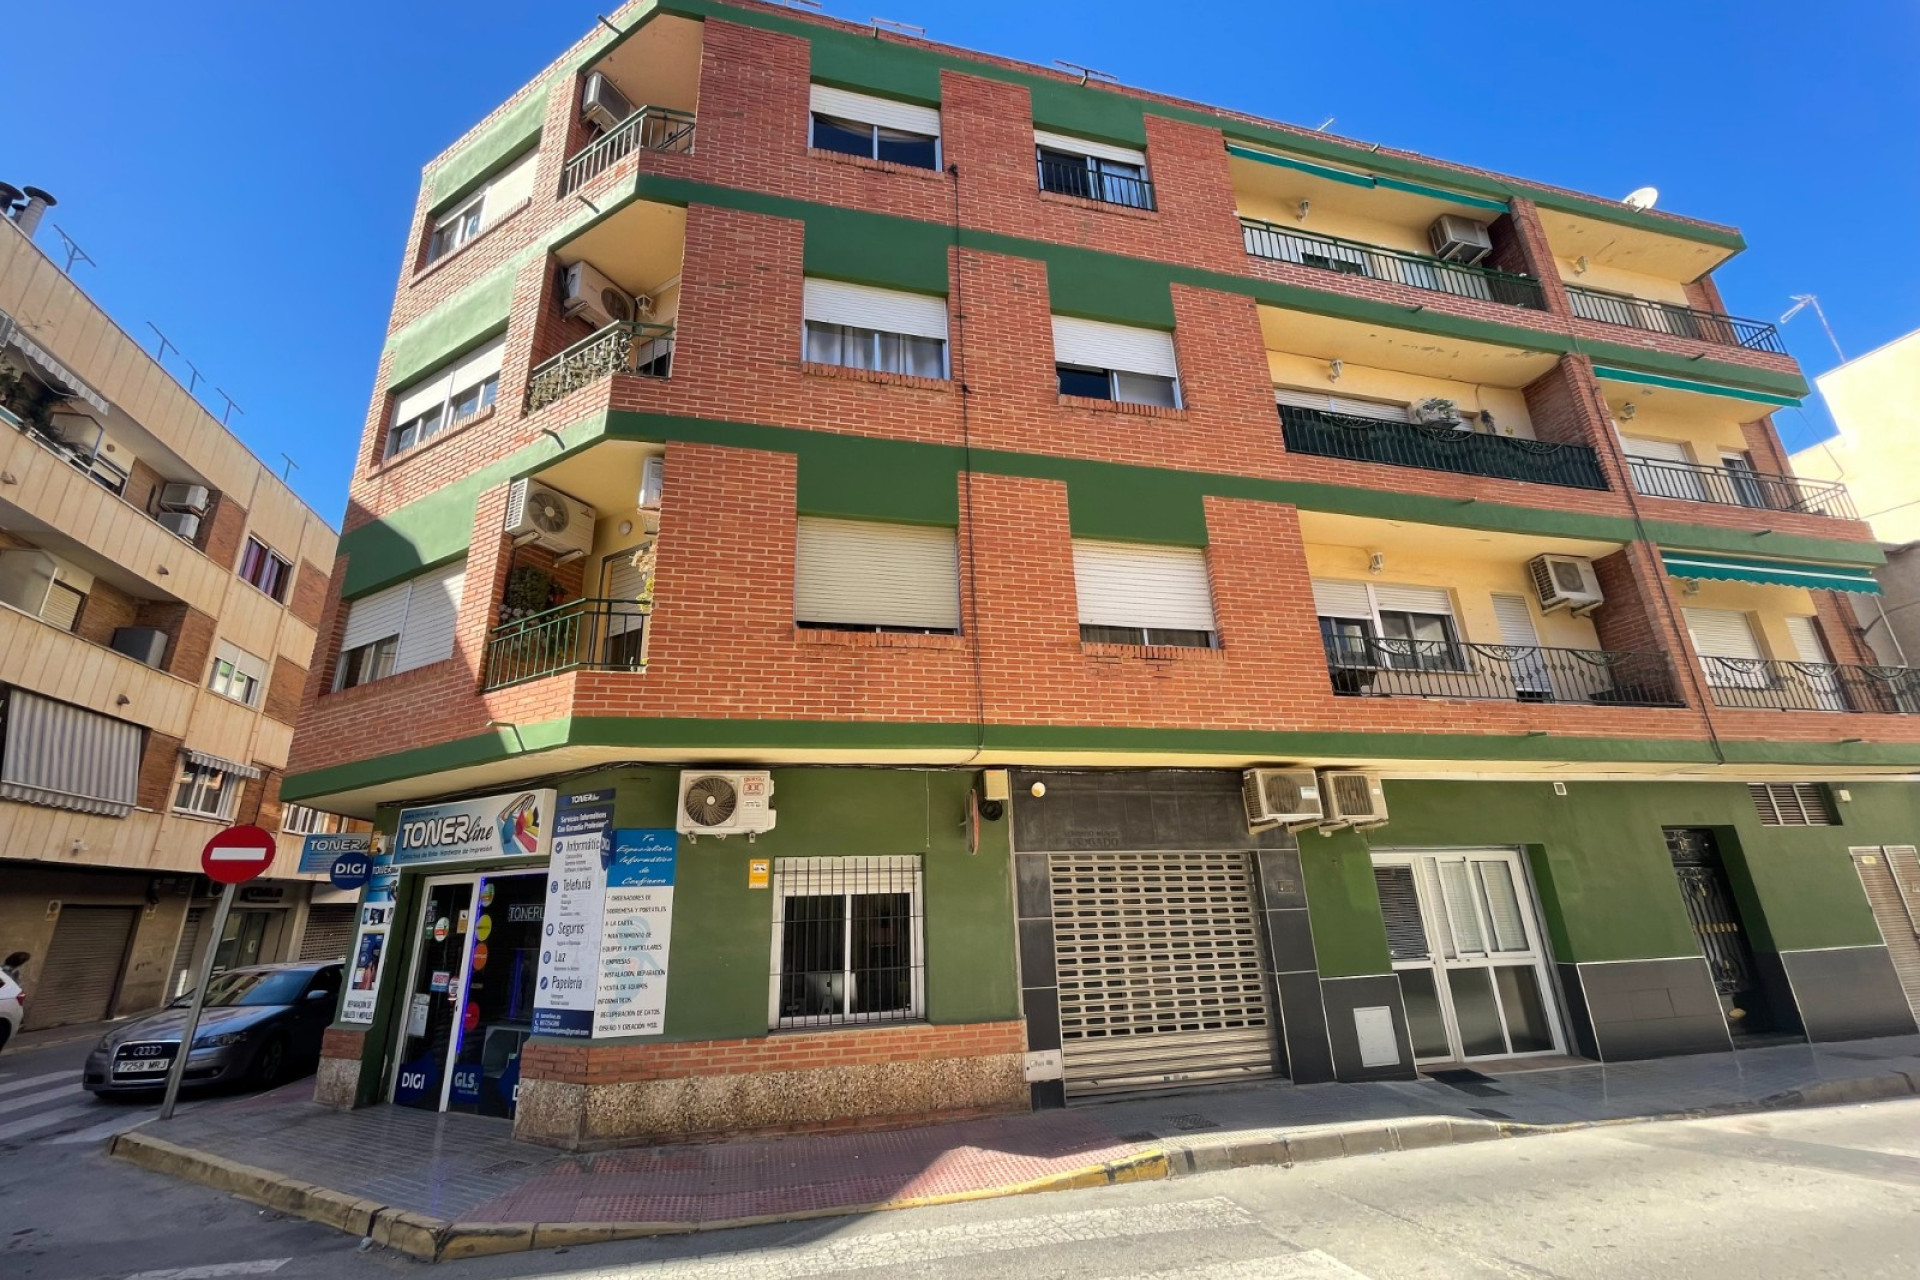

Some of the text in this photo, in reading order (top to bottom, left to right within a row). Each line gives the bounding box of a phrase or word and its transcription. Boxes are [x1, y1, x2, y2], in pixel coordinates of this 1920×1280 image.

[566, 838, 600, 852] Informátic
[335, 863, 367, 874] DIGI
[563, 877, 591, 891] Telefonía
[558, 921, 585, 937] Seguros
[554, 949, 566, 963] Luz
[551, 975, 583, 991] Papelería
[401, 1072, 426, 1090] DIGI
[454, 1071, 475, 1088] GLS
